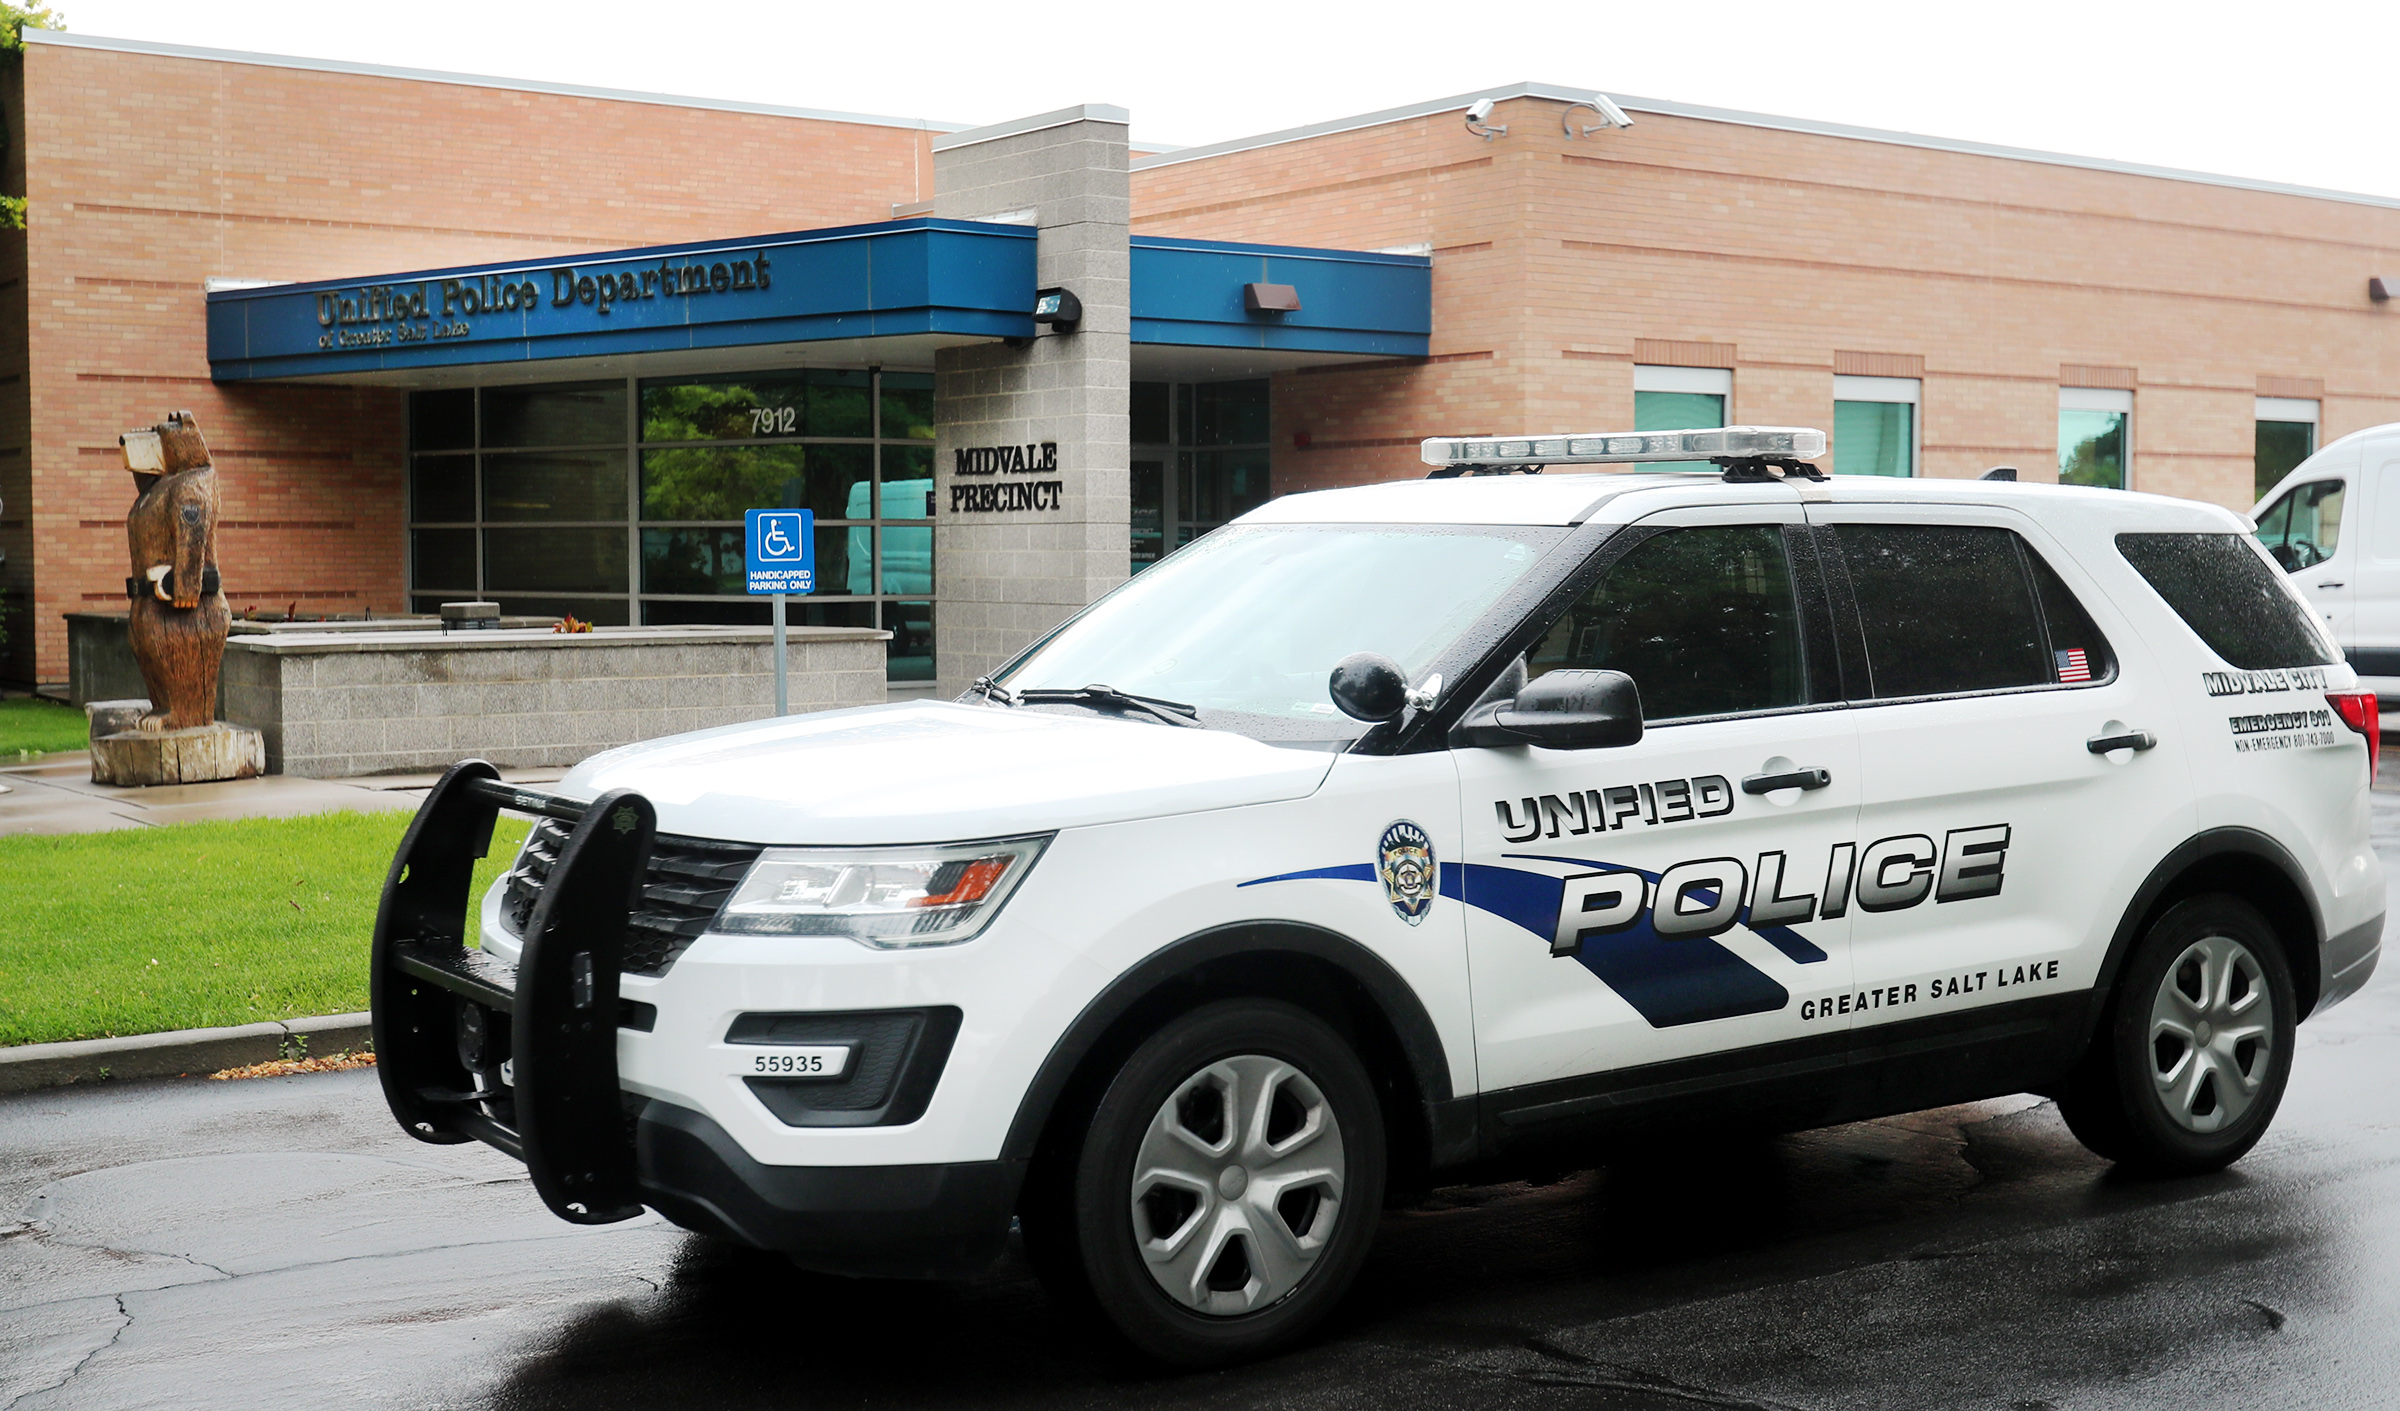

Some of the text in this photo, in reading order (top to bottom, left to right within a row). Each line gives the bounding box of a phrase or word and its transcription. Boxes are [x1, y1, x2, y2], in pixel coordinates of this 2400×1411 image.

[313, 250, 771, 326] Unified Police Department
[318, 319, 470, 349] of Greater Salt Lake
[750, 406, 796, 434] 7912
[954, 442, 1058, 476] MIDVALE
[950, 480, 1063, 512] PRECINCT
[749, 580, 812, 591] PARKING ONLY
[750, 570, 811, 581] HANDICAPPED
[2203, 669, 2328, 697] MIDVALE CITY
[2229, 709, 2332, 734] EMERGENCY 911
[2234, 734, 2292, 753] NON-EMERGENCY
[1494, 774, 1734, 843] UNIFIED
[1393, 847, 1418, 857] POLICE
[1549, 822, 2012, 958] POLICE
[1799, 959, 2062, 1021] GREATER SALT LAKE
[755, 1056, 822, 1072] 55935
